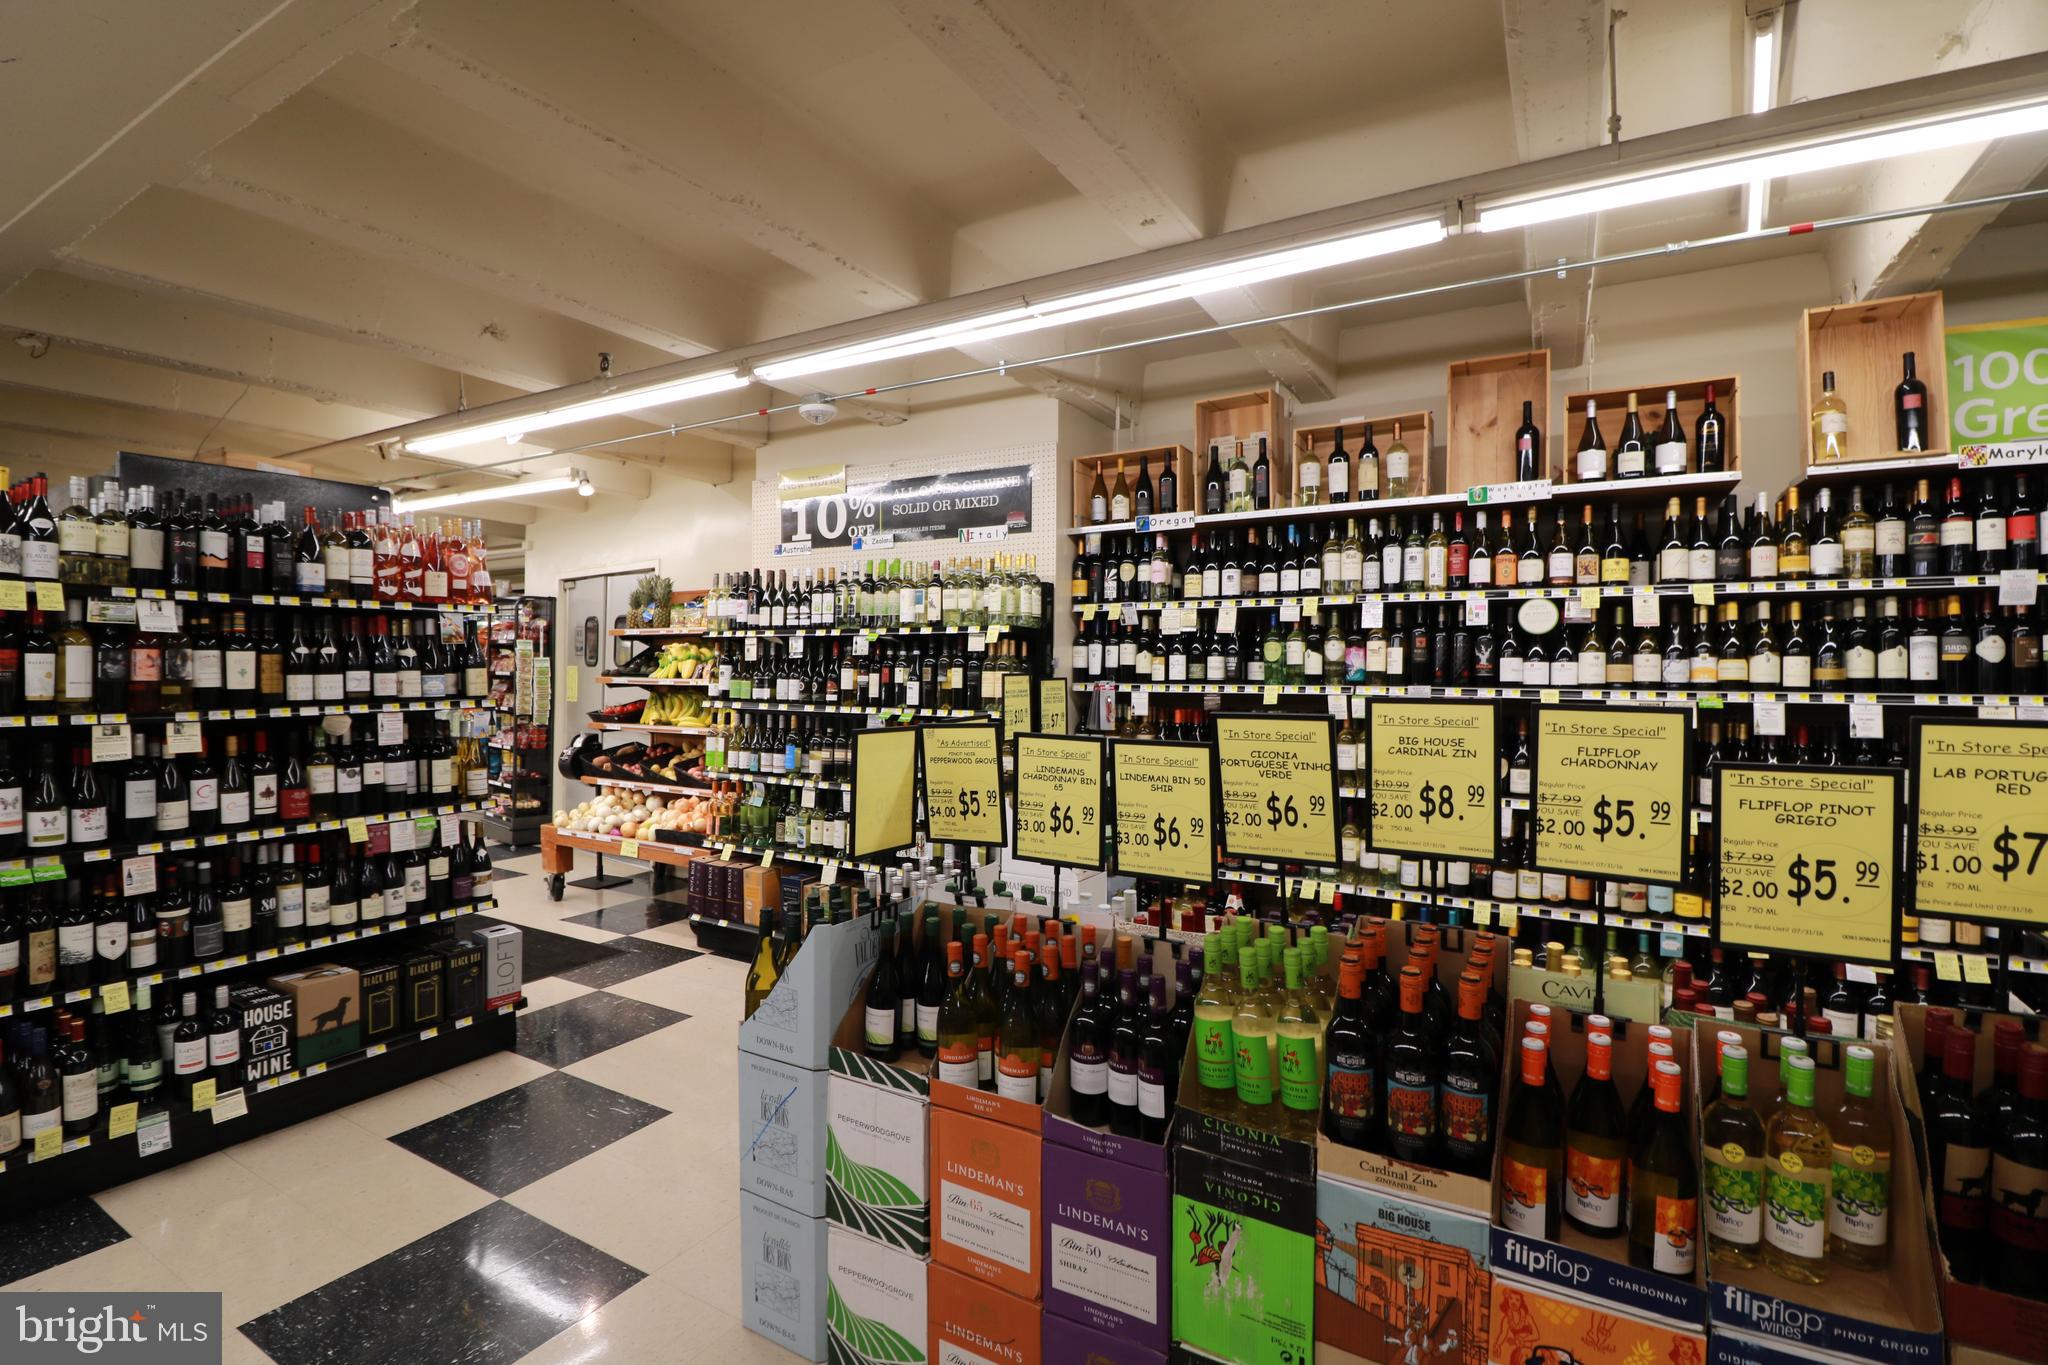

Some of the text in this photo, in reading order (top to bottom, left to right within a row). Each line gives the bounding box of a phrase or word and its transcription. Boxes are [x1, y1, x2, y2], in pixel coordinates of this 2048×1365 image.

[984, 476, 1020, 489] WINE
[892, 496, 999, 516] SOLID OR MIXED
[1150, 517, 1195, 526] Oregon
[848, 524, 875, 538] OFF
[783, 545, 812, 554] Australia
[1944, 644, 1968, 653] napa
[1399, 716, 1429, 726] Store
[1244, 731, 1271, 740] Store
[1570, 724, 1608, 735] Store
[1398, 736, 1465, 748] BIG HOUSE
[1962, 741, 2012, 754] Store
[1037, 748, 1058, 757] Store
[1250, 750, 1298, 760] CICONIA
[1388, 747, 1477, 758] CARDINAL ZIN
[1578, 746, 1641, 758] FLIPFLOP
[930, 756, 972, 764] PEPPERWOOD
[1136, 756, 1160, 764] Store
[1220, 758, 1332, 772] PORTUGUESE VINHO
[1561, 757, 1658, 772] CHARDONNAY
[1036, 765, 1085, 776] LINDEMANS
[1259, 770, 1292, 780] VERDE
[1933, 768, 1966, 778] LAB
[1022, 772, 1097, 786] CHARDONNAY BIN
[1120, 772, 1206, 786] LINDEMAN BIN 50
[1760, 775, 1804, 788] Store
[1054, 784, 1064, 792] 65
[1150, 784, 1174, 792] SHIR
[1996, 783, 2032, 796] RED
[930, 806, 956, 818] $4.00
[1739, 799, 1876, 816] FLIPFLOP PINOT
[1920, 808, 1983, 820] Regular Price
[1774, 814, 1838, 828] GRIGIO
[1723, 837, 1778, 848] Regular Price
[1944, 842, 1976, 851] SAVE
[1916, 850, 1982, 875] $1.00
[1745, 868, 1773, 878] SAVE
[1946, 882, 1964, 890] 750
[1968, 882, 1982, 892] ML
[1747, 906, 1763, 915] 750
[1766, 907, 1778, 916] ML
[450, 955, 468, 969] BLACK
[496, 937, 515, 990] LOFT
[409, 963, 429, 977] BLACK
[244, 1000, 293, 1029] HOUSE
[756, 1035, 794, 1054] DOWN-BAS
[247, 1052, 292, 1082] WINE
[1203, 1117, 1280, 1147] CICONIA
[1359, 1159, 1409, 1182] Cardinal
[946, 1160, 1024, 1197] LINDEMAN'S
[1375, 1176, 1418, 1192] ZINFANDEL
[756, 1176, 794, 1198] DOWN-BAS
[970, 1198, 984, 1213] 65
[947, 1214, 996, 1236] CHARDONNAY
[1058, 1203, 1150, 1242] LINDEMAN'S
[1378, 1208, 1431, 1232] BIG HOUSE
[1059, 1237, 1102, 1259] Bin 50
[1058, 1258, 1089, 1274] SHIRAZ
[1504, 1238, 1688, 1306] flipflop CHARDONNAY
[1724, 1286, 1823, 1334] flipflop
[945, 1320, 1023, 1364] LINDEMAN'S
[1760, 1319, 1930, 1356] wines PINOT GRIGIO
